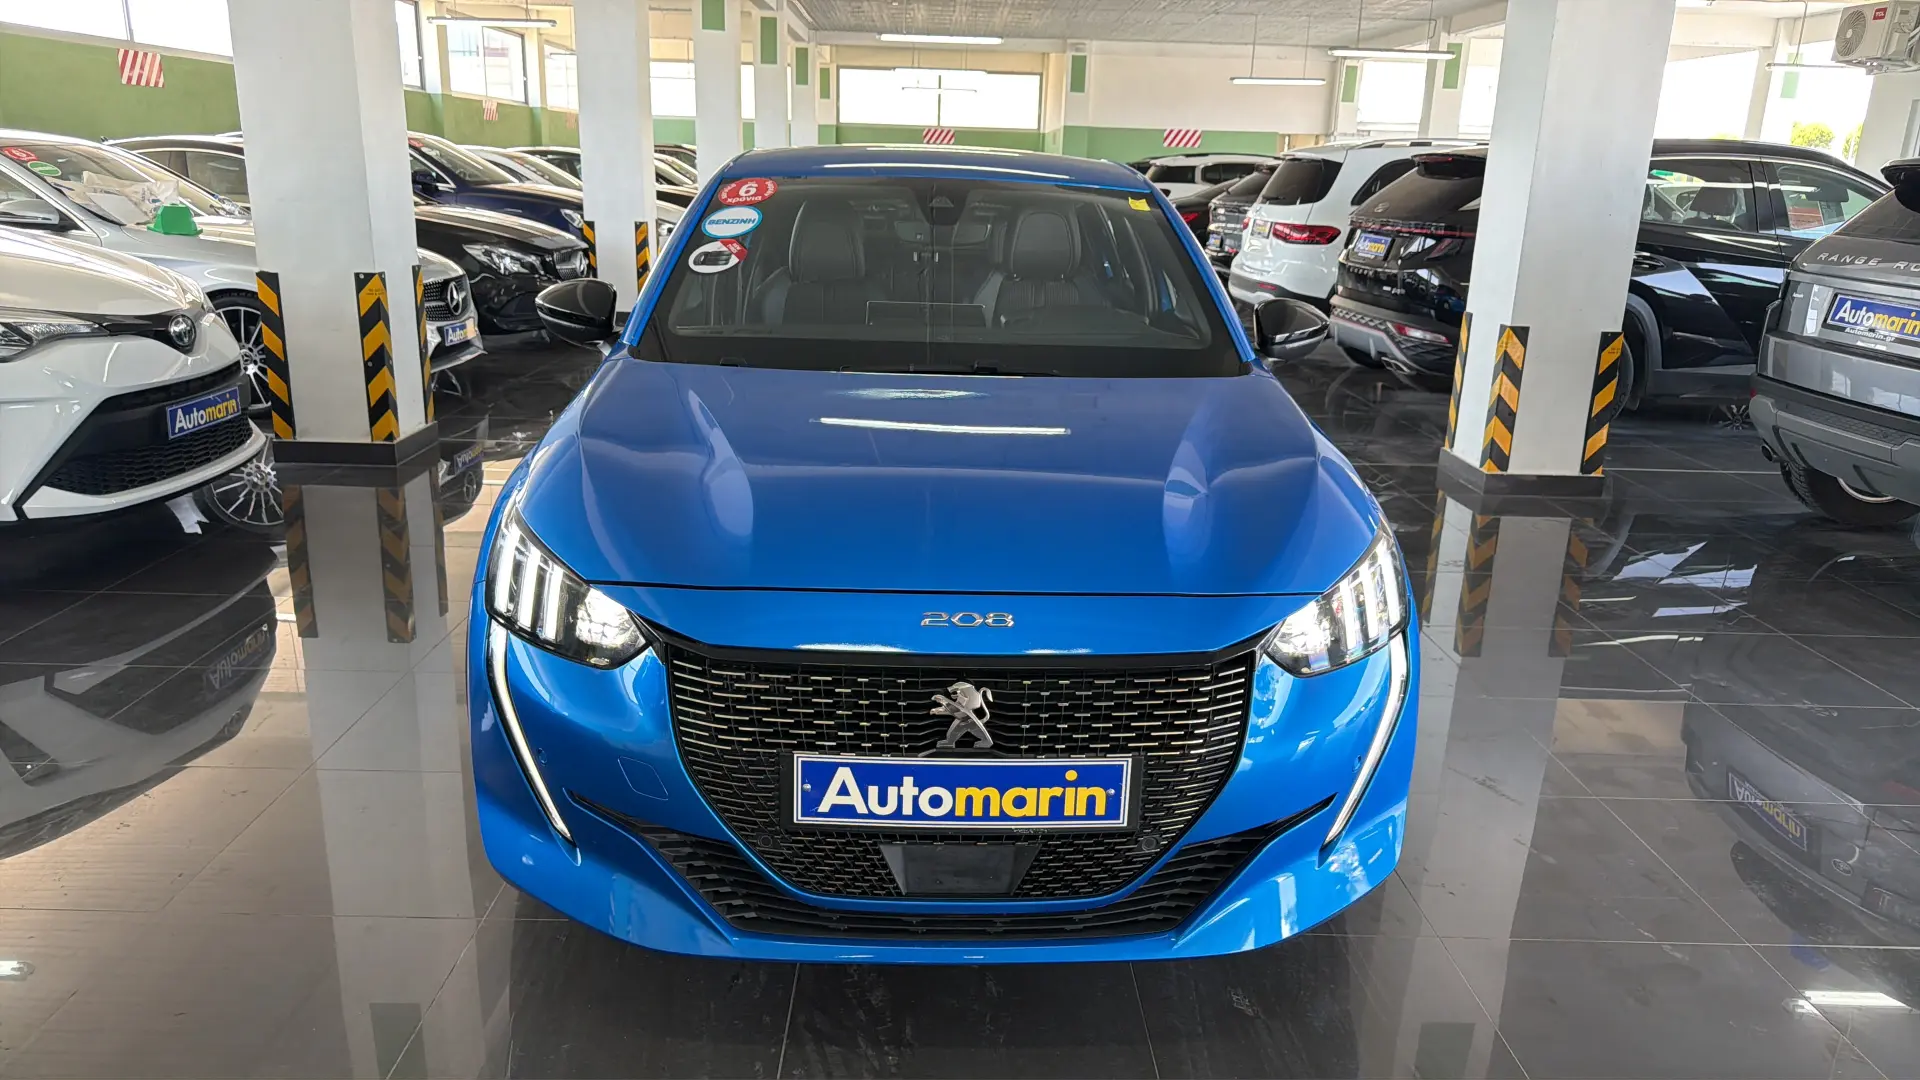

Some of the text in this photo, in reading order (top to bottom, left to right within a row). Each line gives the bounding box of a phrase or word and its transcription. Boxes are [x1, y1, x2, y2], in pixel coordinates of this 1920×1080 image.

[739, 183, 758, 197] 6
[1817, 252, 1882, 266] RANGE
[1844, 326, 1896, 342] Automarin.gr
[174, 393, 237, 433] Automarin
[920, 612, 1015, 628] 208
[817, 766, 1107, 818] Automarin
